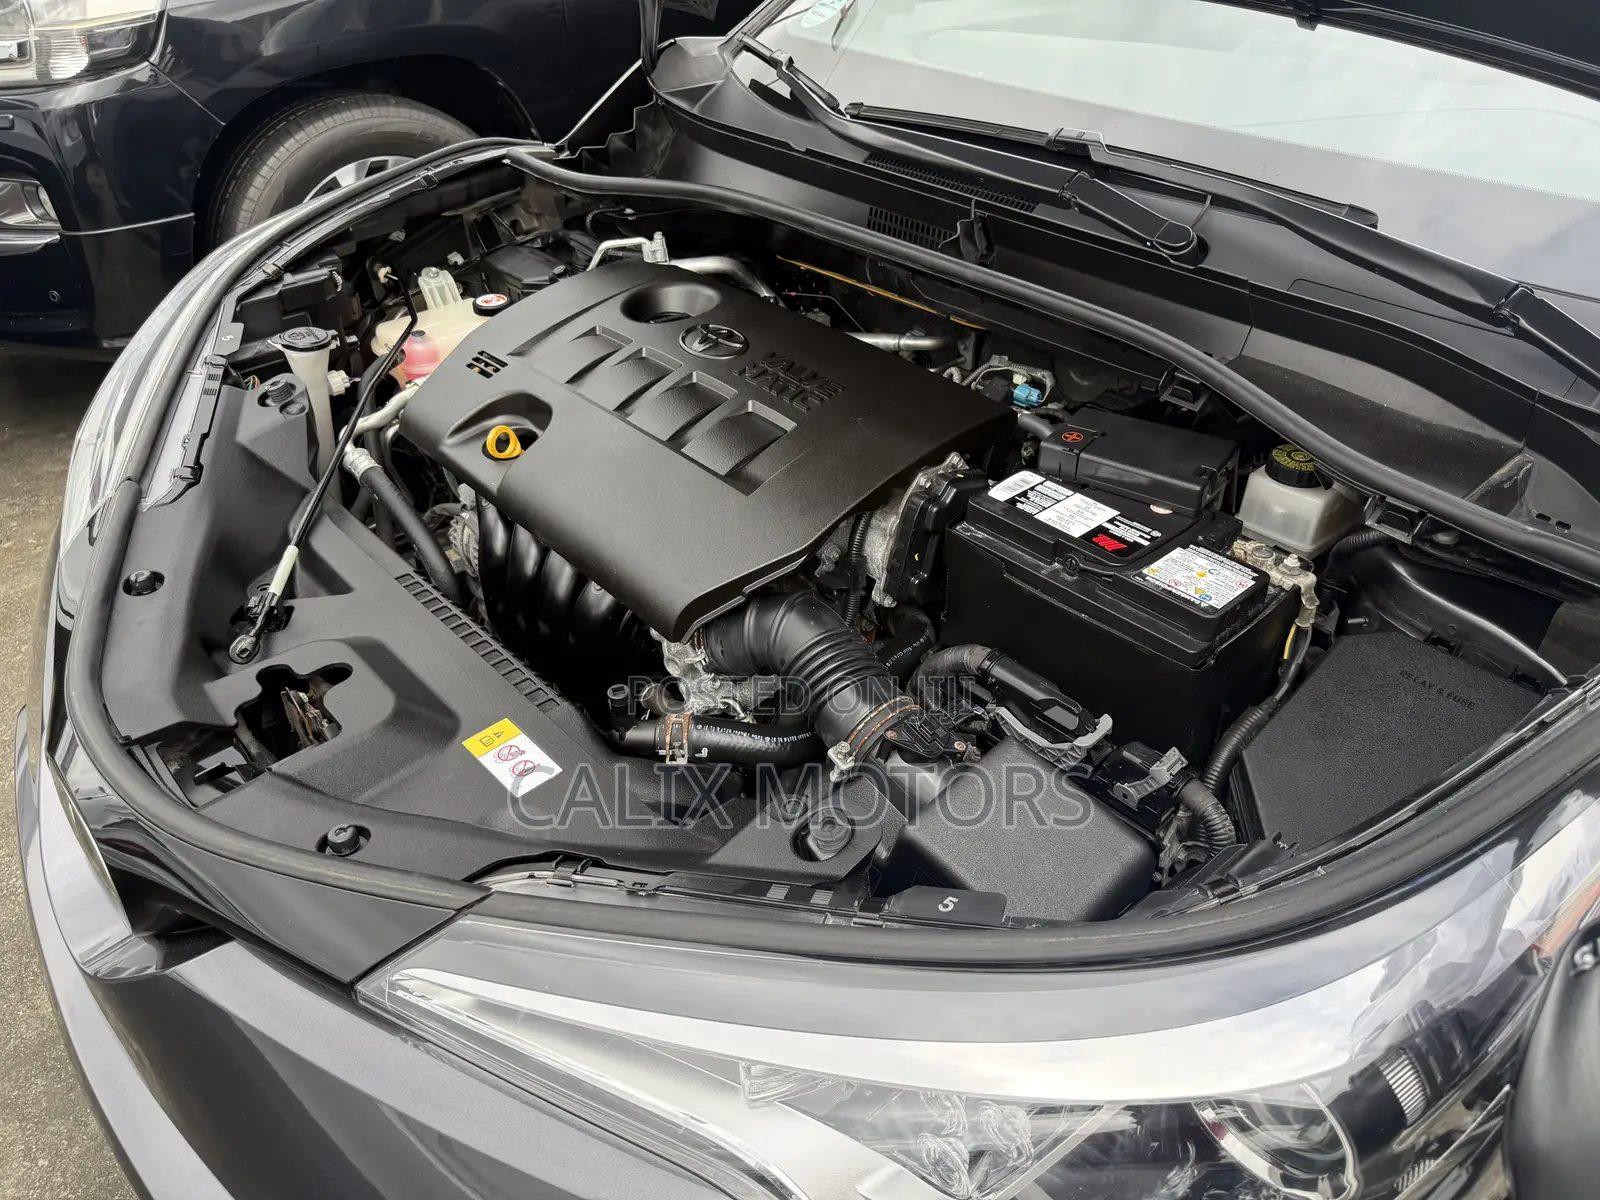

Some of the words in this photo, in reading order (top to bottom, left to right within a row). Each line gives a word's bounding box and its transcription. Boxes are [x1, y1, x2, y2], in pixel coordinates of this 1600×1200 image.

[1400, 670, 1435, 689] RELAY
[1436, 687, 1445, 697] &
[1446, 691, 1477, 710] FUSE
[938, 896, 959, 912] 5
